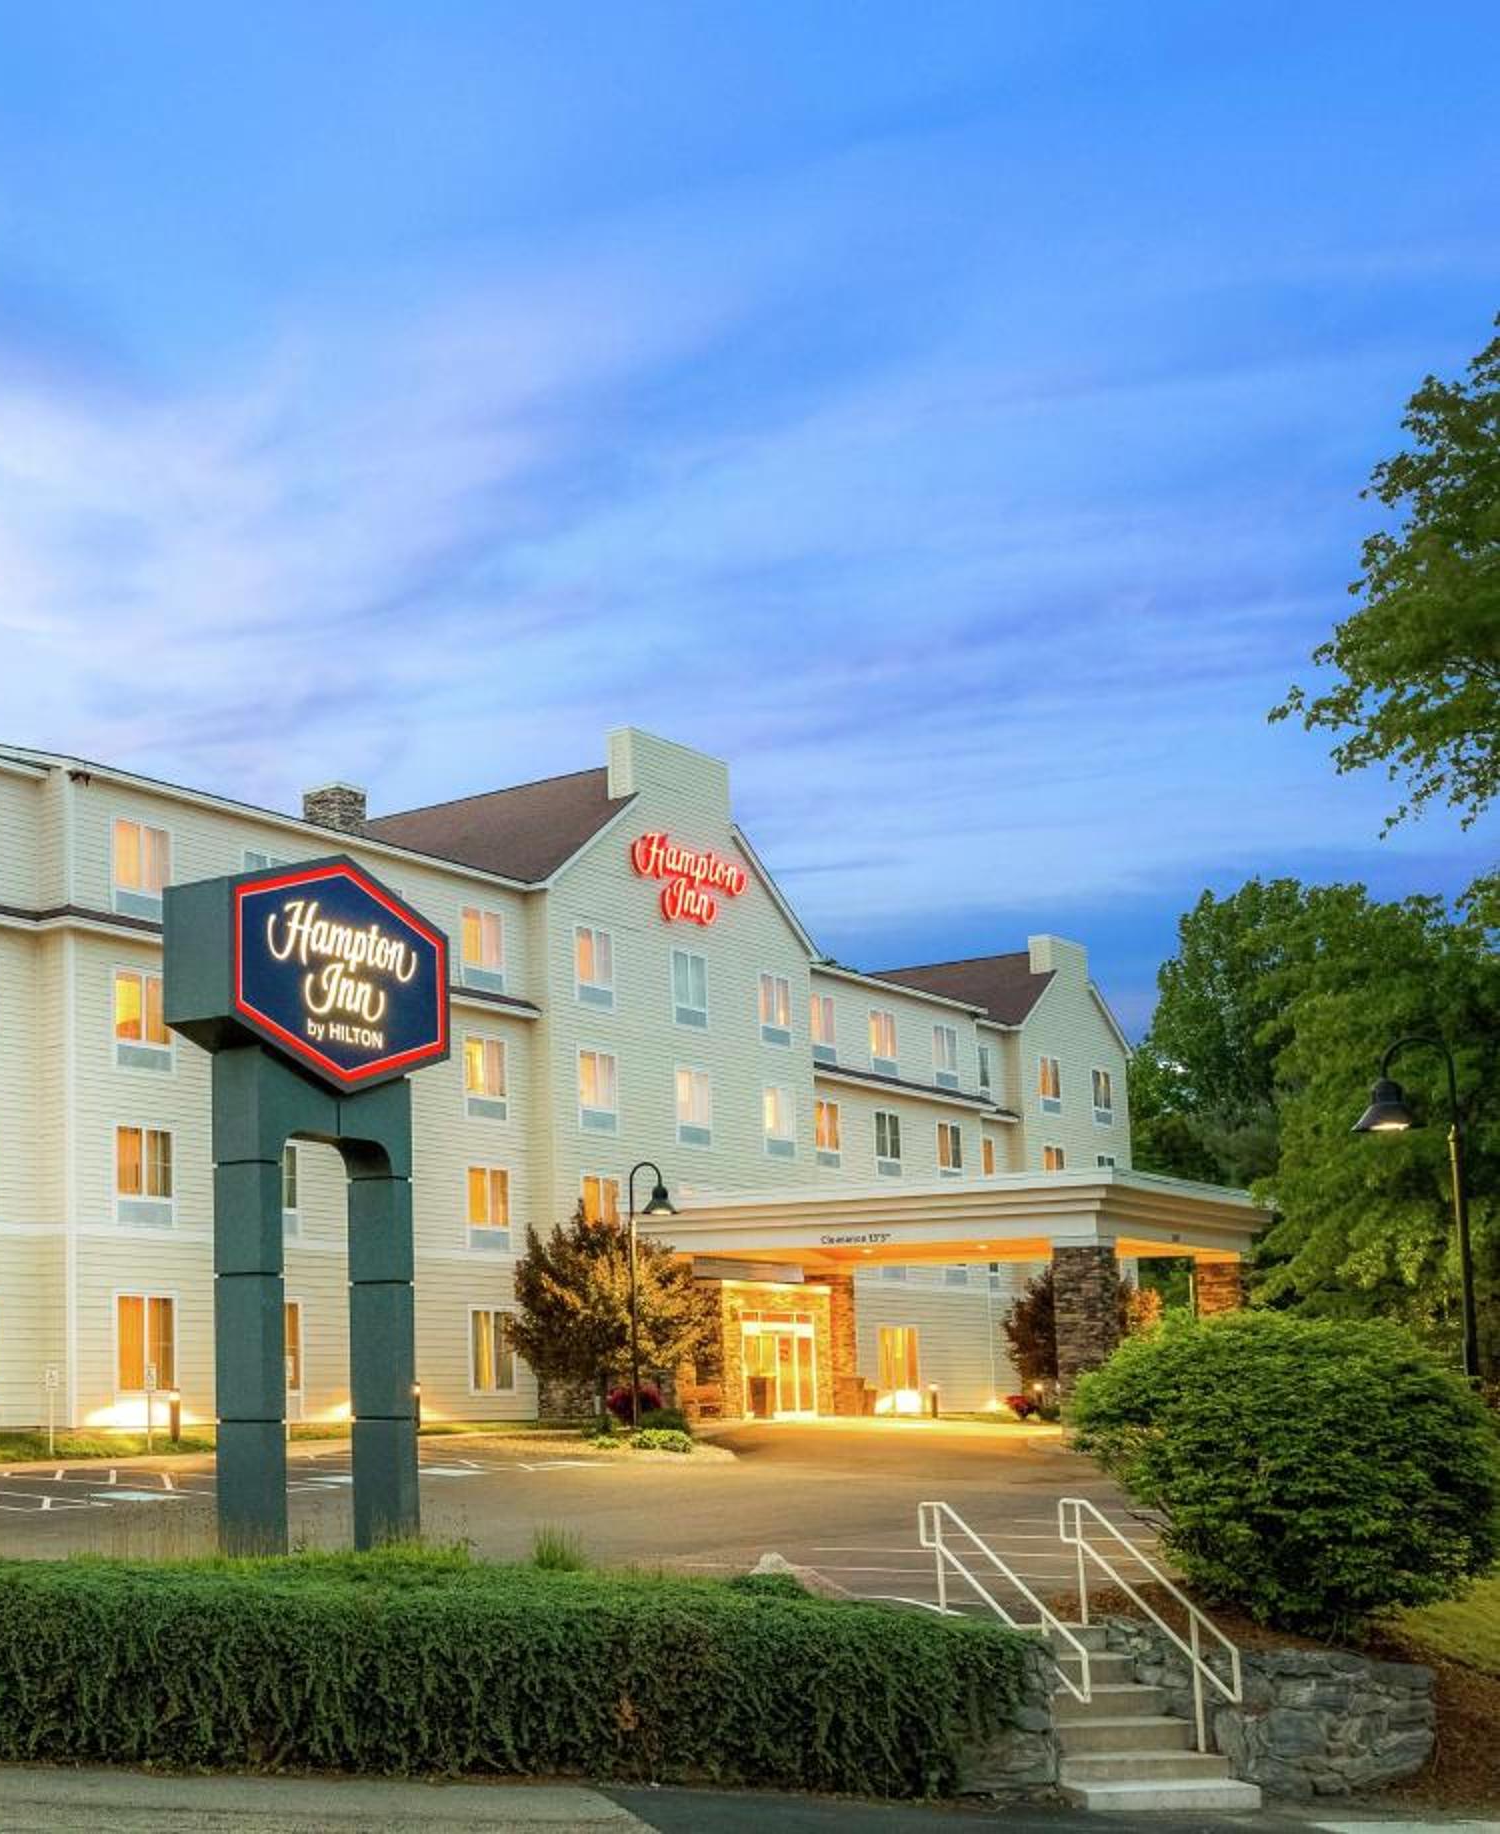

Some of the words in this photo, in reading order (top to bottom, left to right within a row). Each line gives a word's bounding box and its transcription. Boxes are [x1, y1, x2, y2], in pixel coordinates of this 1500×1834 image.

[631, 832, 747, 896] Hampton
[661, 878, 717, 925] Inn
[267, 901, 418, 983] Hampton
[305, 963, 386, 1023] Inn
[307, 1018, 325, 1041] by
[329, 1022, 384, 1050] HILTON
